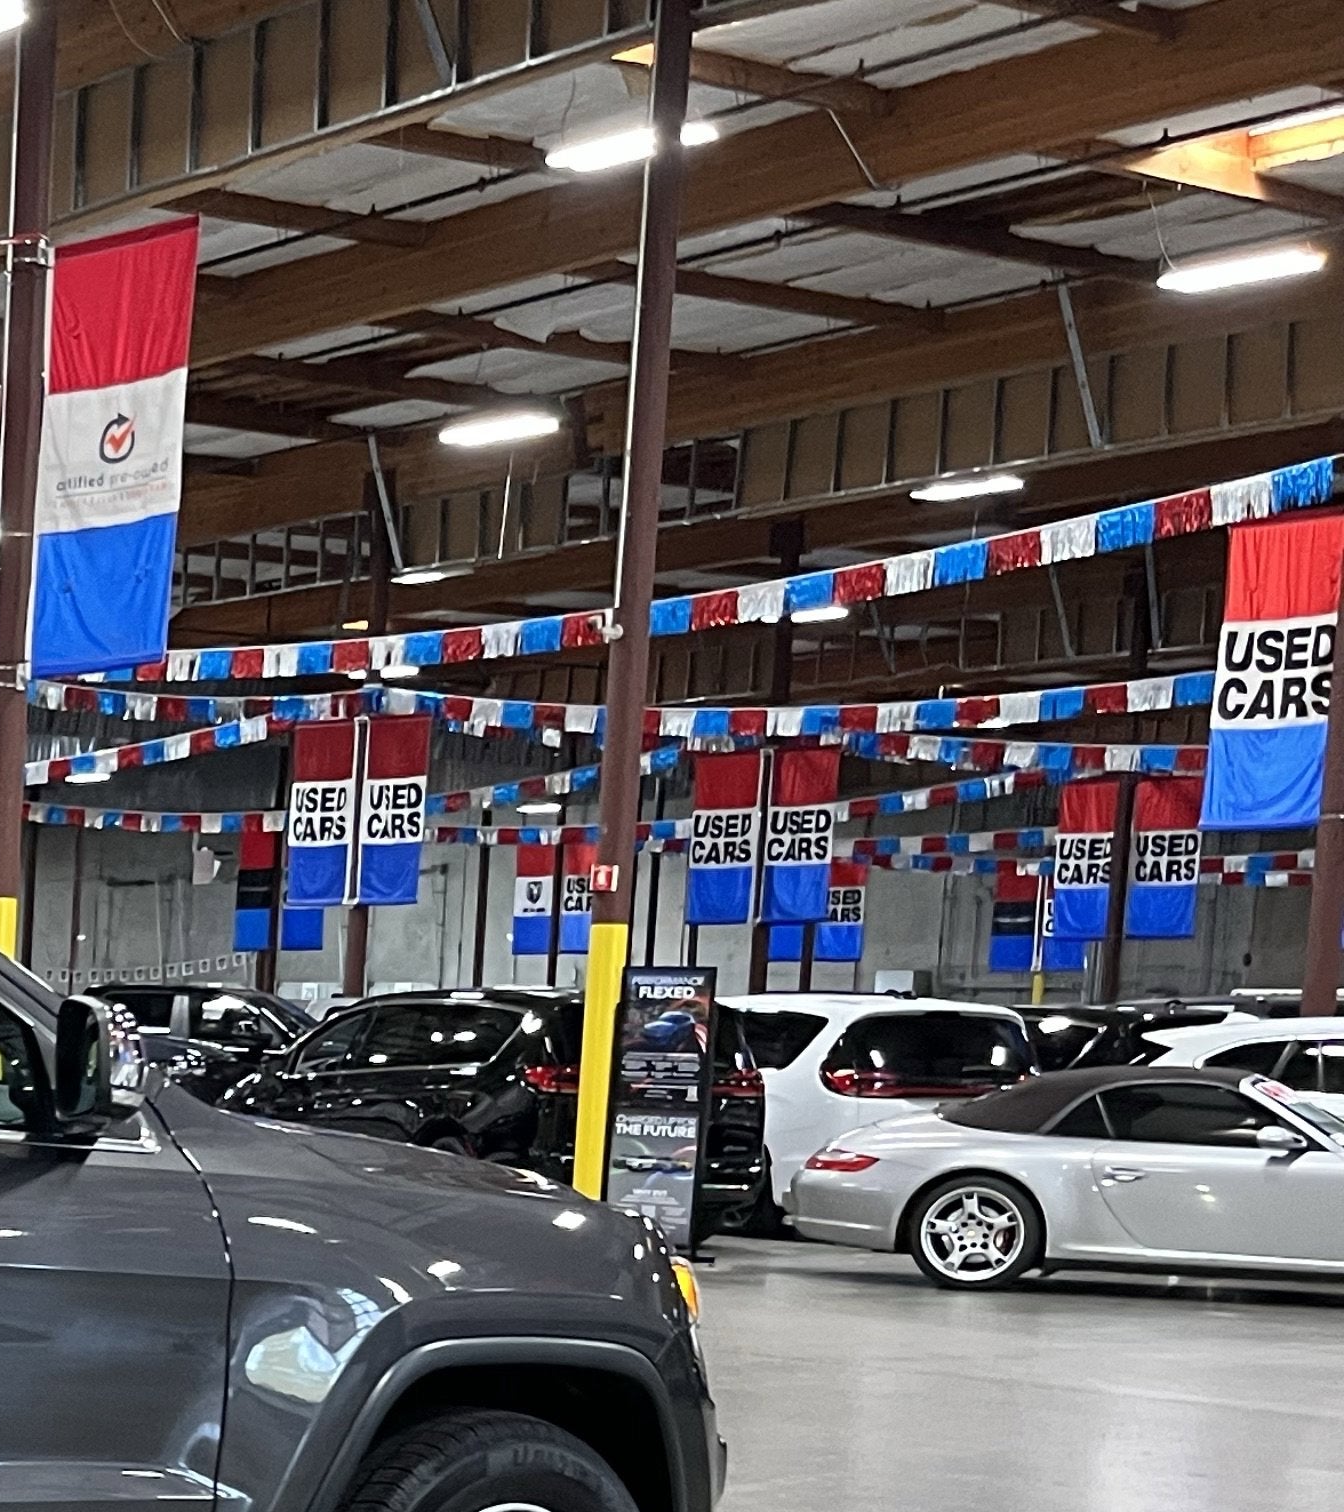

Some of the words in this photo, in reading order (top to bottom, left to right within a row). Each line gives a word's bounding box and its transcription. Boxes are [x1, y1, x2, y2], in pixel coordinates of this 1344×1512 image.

[56, 473, 104, 492] ctified
[1224, 624, 1337, 673] USED
[1217, 671, 1333, 720] CARS
[295, 787, 347, 813] USED
[369, 782, 423, 811] USED
[293, 815, 346, 841] CARS
[367, 811, 421, 839] CARS
[694, 813, 752, 839] USED
[770, 809, 832, 835] USED
[692, 839, 752, 864] CARS
[767, 836, 828, 861] CARS
[1058, 837, 1112, 860] USED
[1135, 834, 1199, 857] USED
[1057, 861, 1112, 884] CARS
[1134, 859, 1197, 882] CARS
[566, 878, 593, 893] US
[828, 889, 862, 905] SED
[564, 896, 593, 912] CA
[829, 906, 861, 922] ARS
[638, 986, 696, 999] FLEXED
[615, 1123, 641, 1136] THE
[643, 1124, 696, 1138] FUTURE
